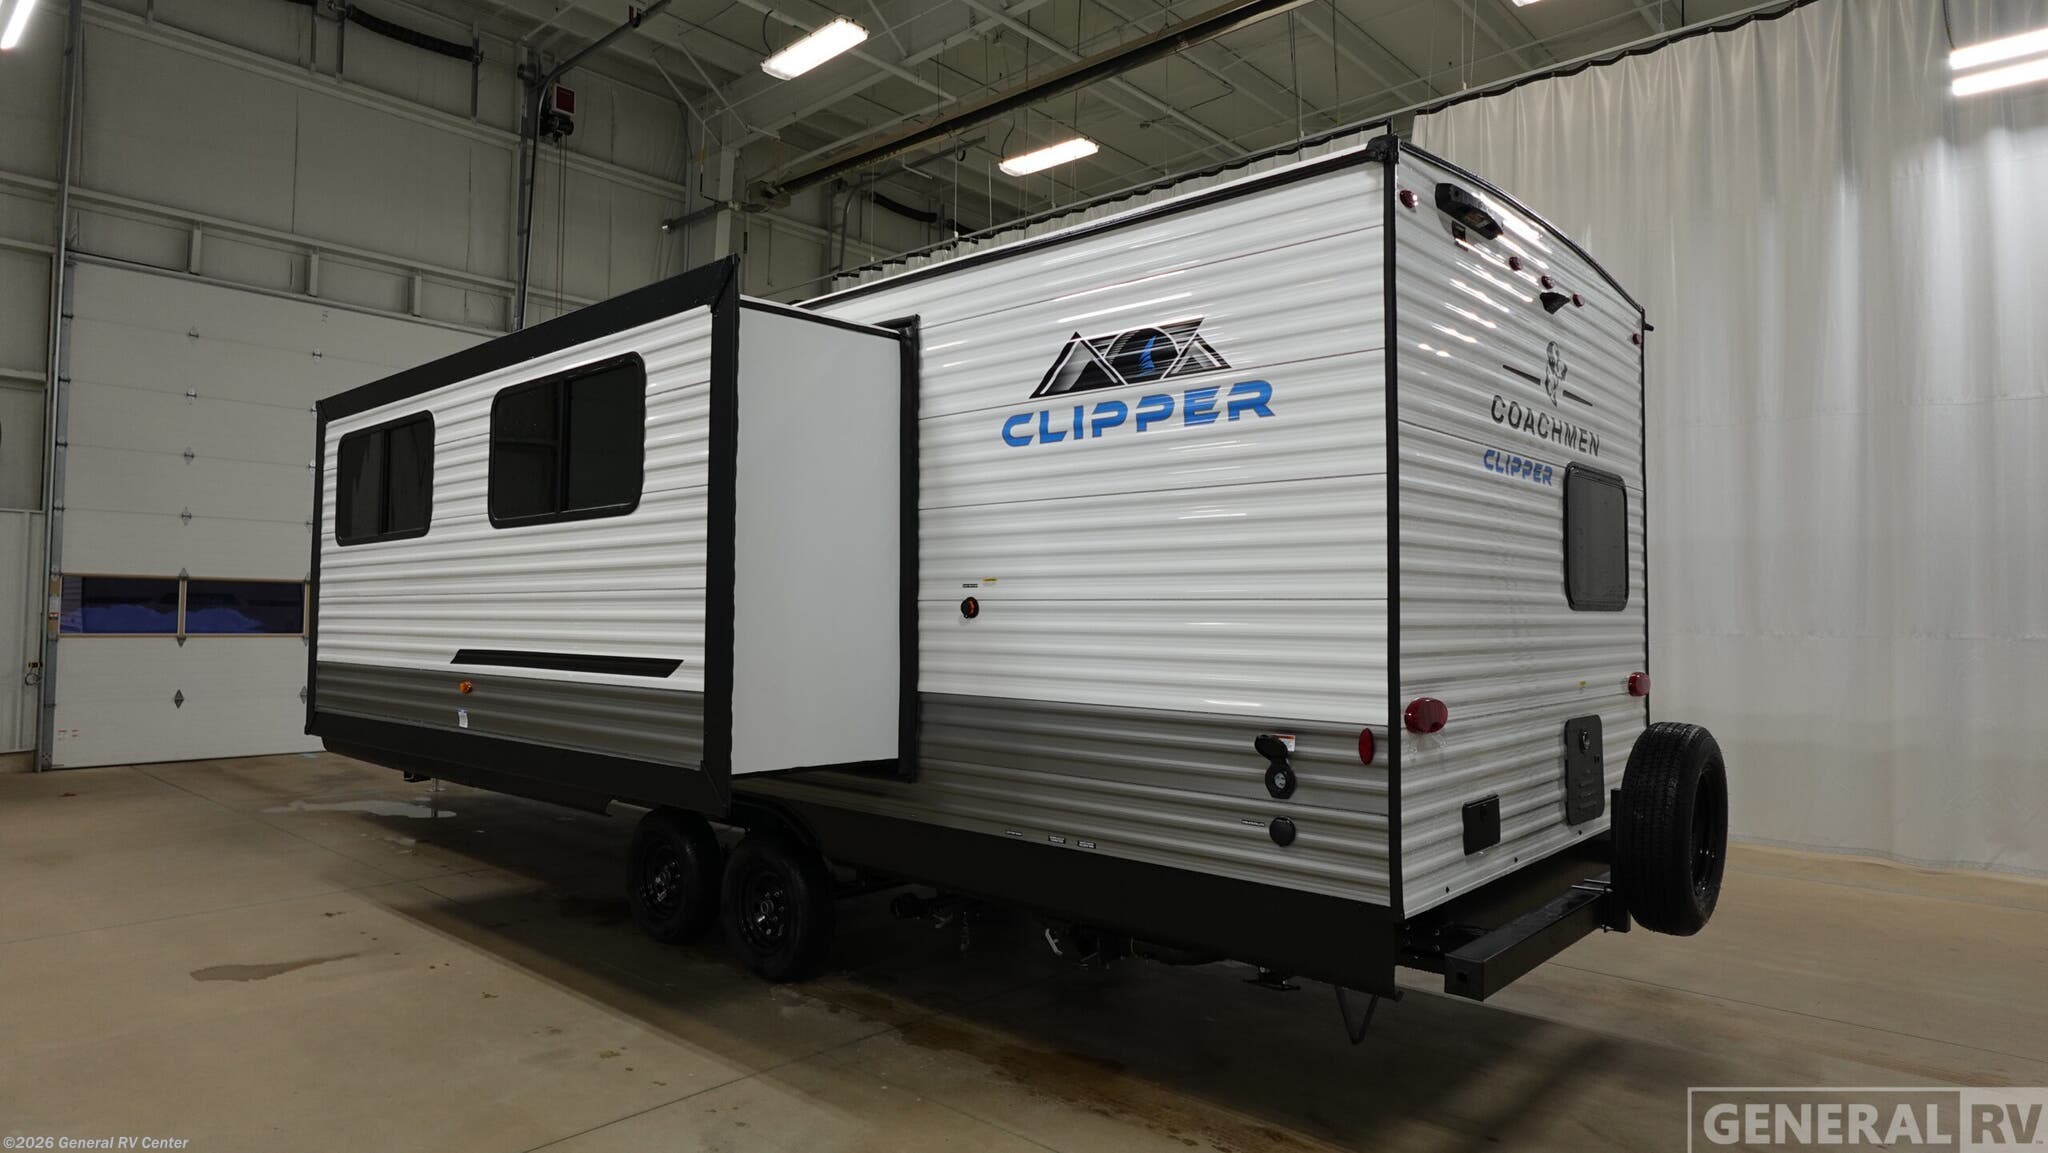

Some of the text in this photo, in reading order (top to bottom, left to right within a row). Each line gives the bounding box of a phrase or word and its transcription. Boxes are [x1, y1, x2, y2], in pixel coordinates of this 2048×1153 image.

[1001, 379, 1276, 448] CLIPPER
[1491, 394, 1600, 457] COACHMEN
[1483, 449, 1553, 486] CLIPPER
